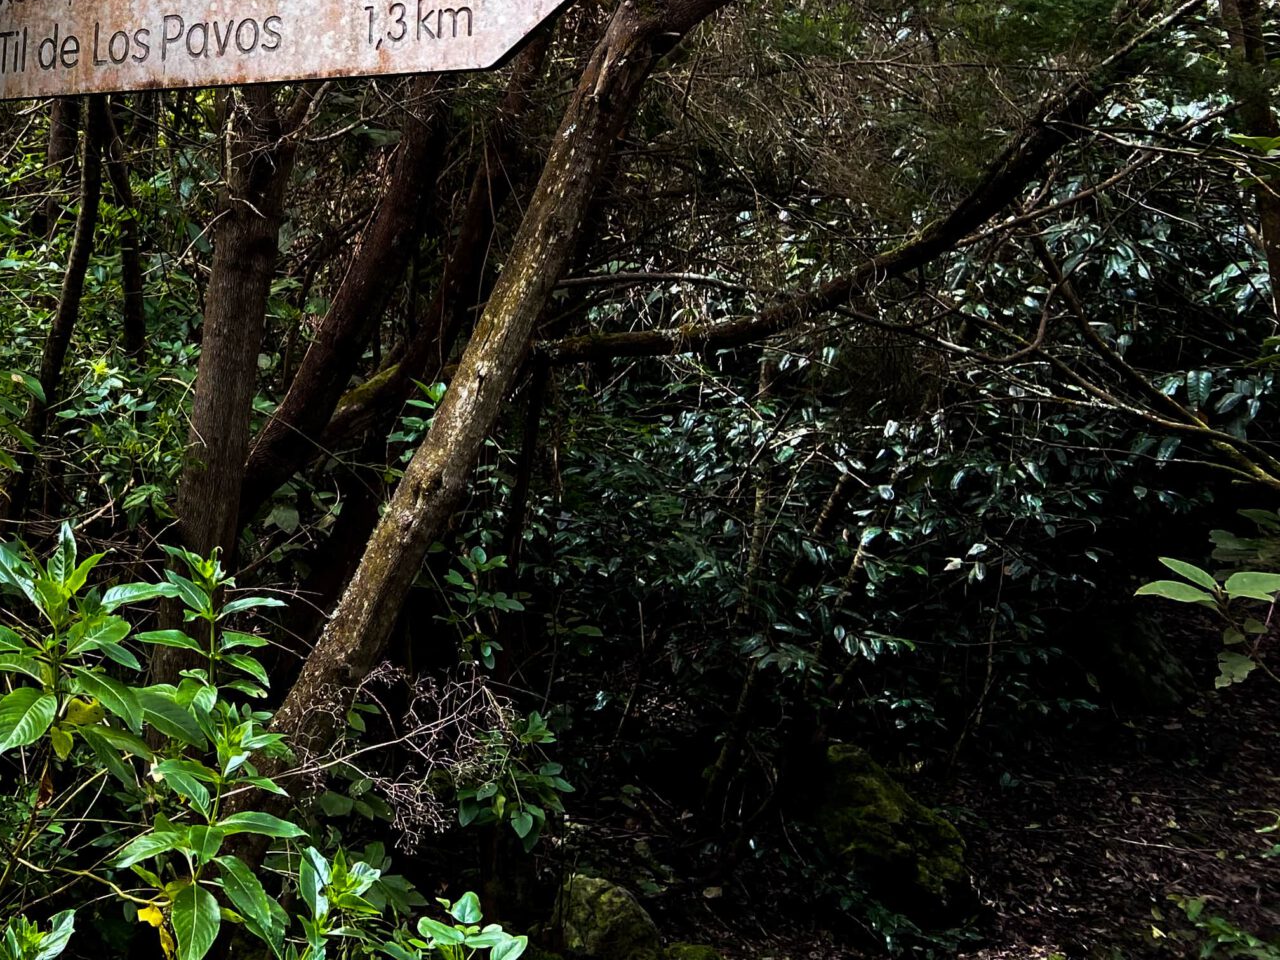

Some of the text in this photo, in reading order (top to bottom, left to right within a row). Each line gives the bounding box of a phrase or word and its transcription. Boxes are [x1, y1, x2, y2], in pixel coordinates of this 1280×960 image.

[37, 22, 81, 70] de
[91, 16, 152, 66] Los
[160, 12, 284, 60] Pavos
